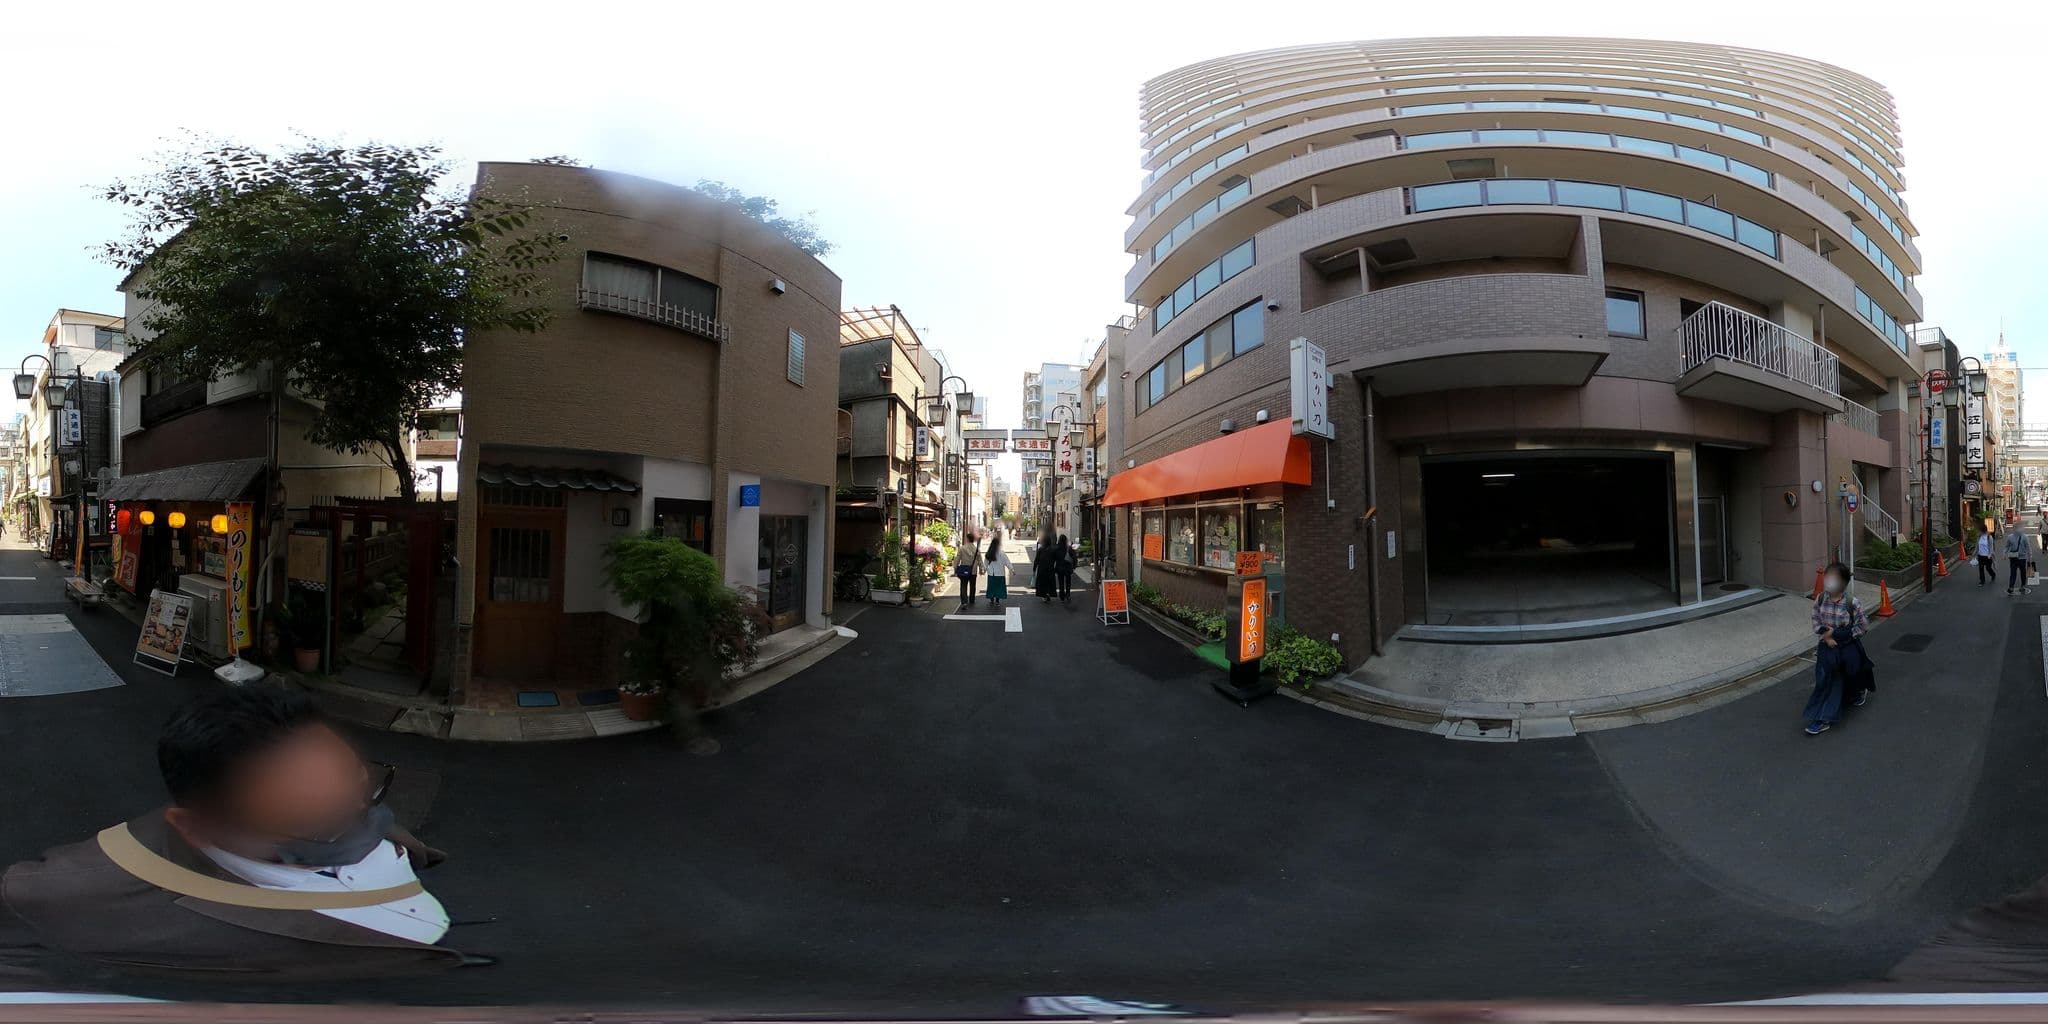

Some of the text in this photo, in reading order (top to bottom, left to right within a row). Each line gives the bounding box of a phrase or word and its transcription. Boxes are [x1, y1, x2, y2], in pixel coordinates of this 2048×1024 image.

[1312, 370, 1323, 427] かりい乃
[971, 440, 1002, 449] 食通街
[1018, 440, 1050, 449] 食通街
[1968, 415, 1982, 460] 江戸定
[1242, 553, 1257, 561] ランチ
[1247, 602, 1260, 656] かりい乃
